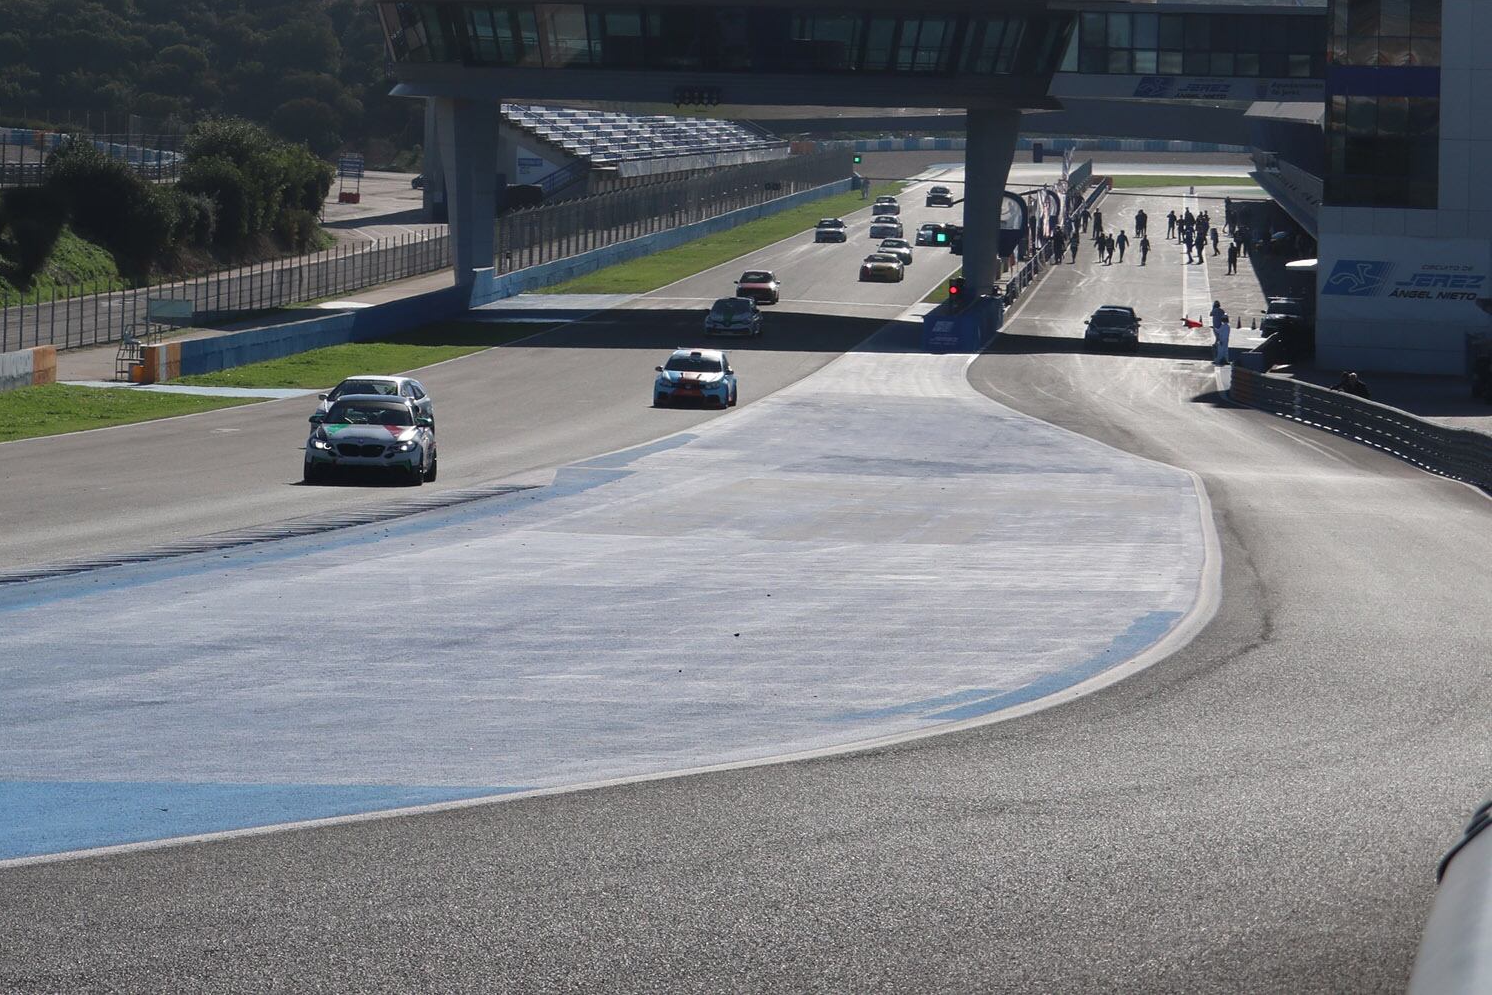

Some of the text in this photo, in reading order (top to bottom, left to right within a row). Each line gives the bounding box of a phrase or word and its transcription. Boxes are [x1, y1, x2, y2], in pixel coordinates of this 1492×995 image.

[1395, 273, 1486, 289] JEREZ
[1388, 287, 1478, 301] ÁNGEL NIETO
